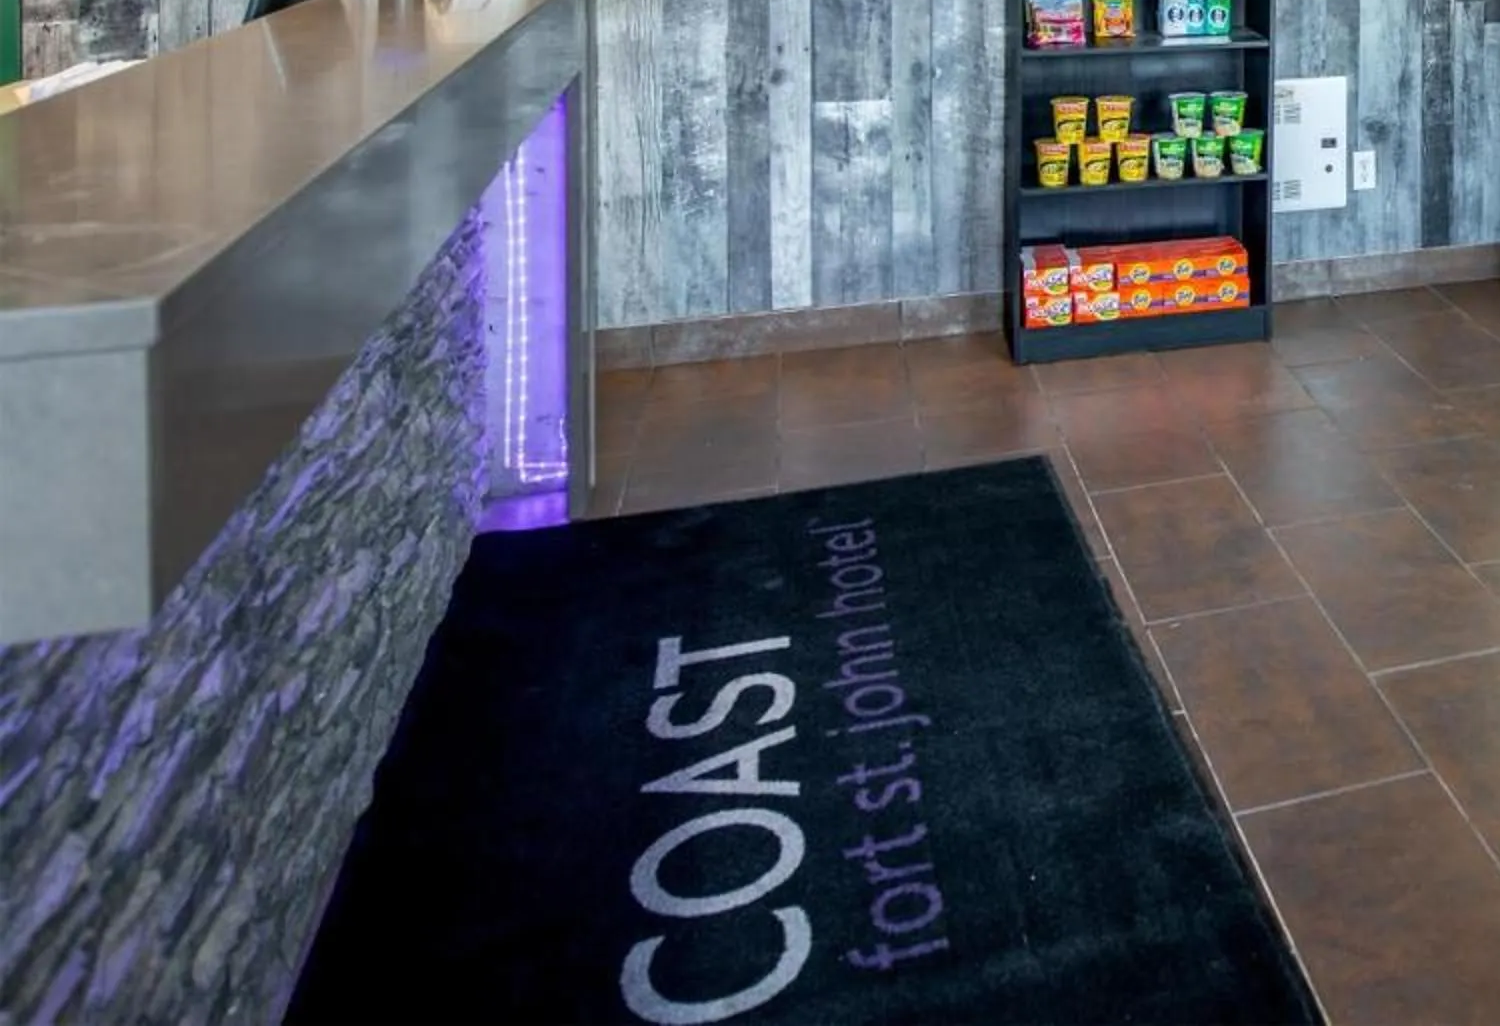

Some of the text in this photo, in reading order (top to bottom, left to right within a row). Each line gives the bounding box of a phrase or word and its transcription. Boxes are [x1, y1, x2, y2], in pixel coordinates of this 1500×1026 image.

[805, 518, 887, 620] hotel
[822, 623, 933, 738] john
[619, 635, 813, 1025] COAST
[843, 823, 950, 971] fort
